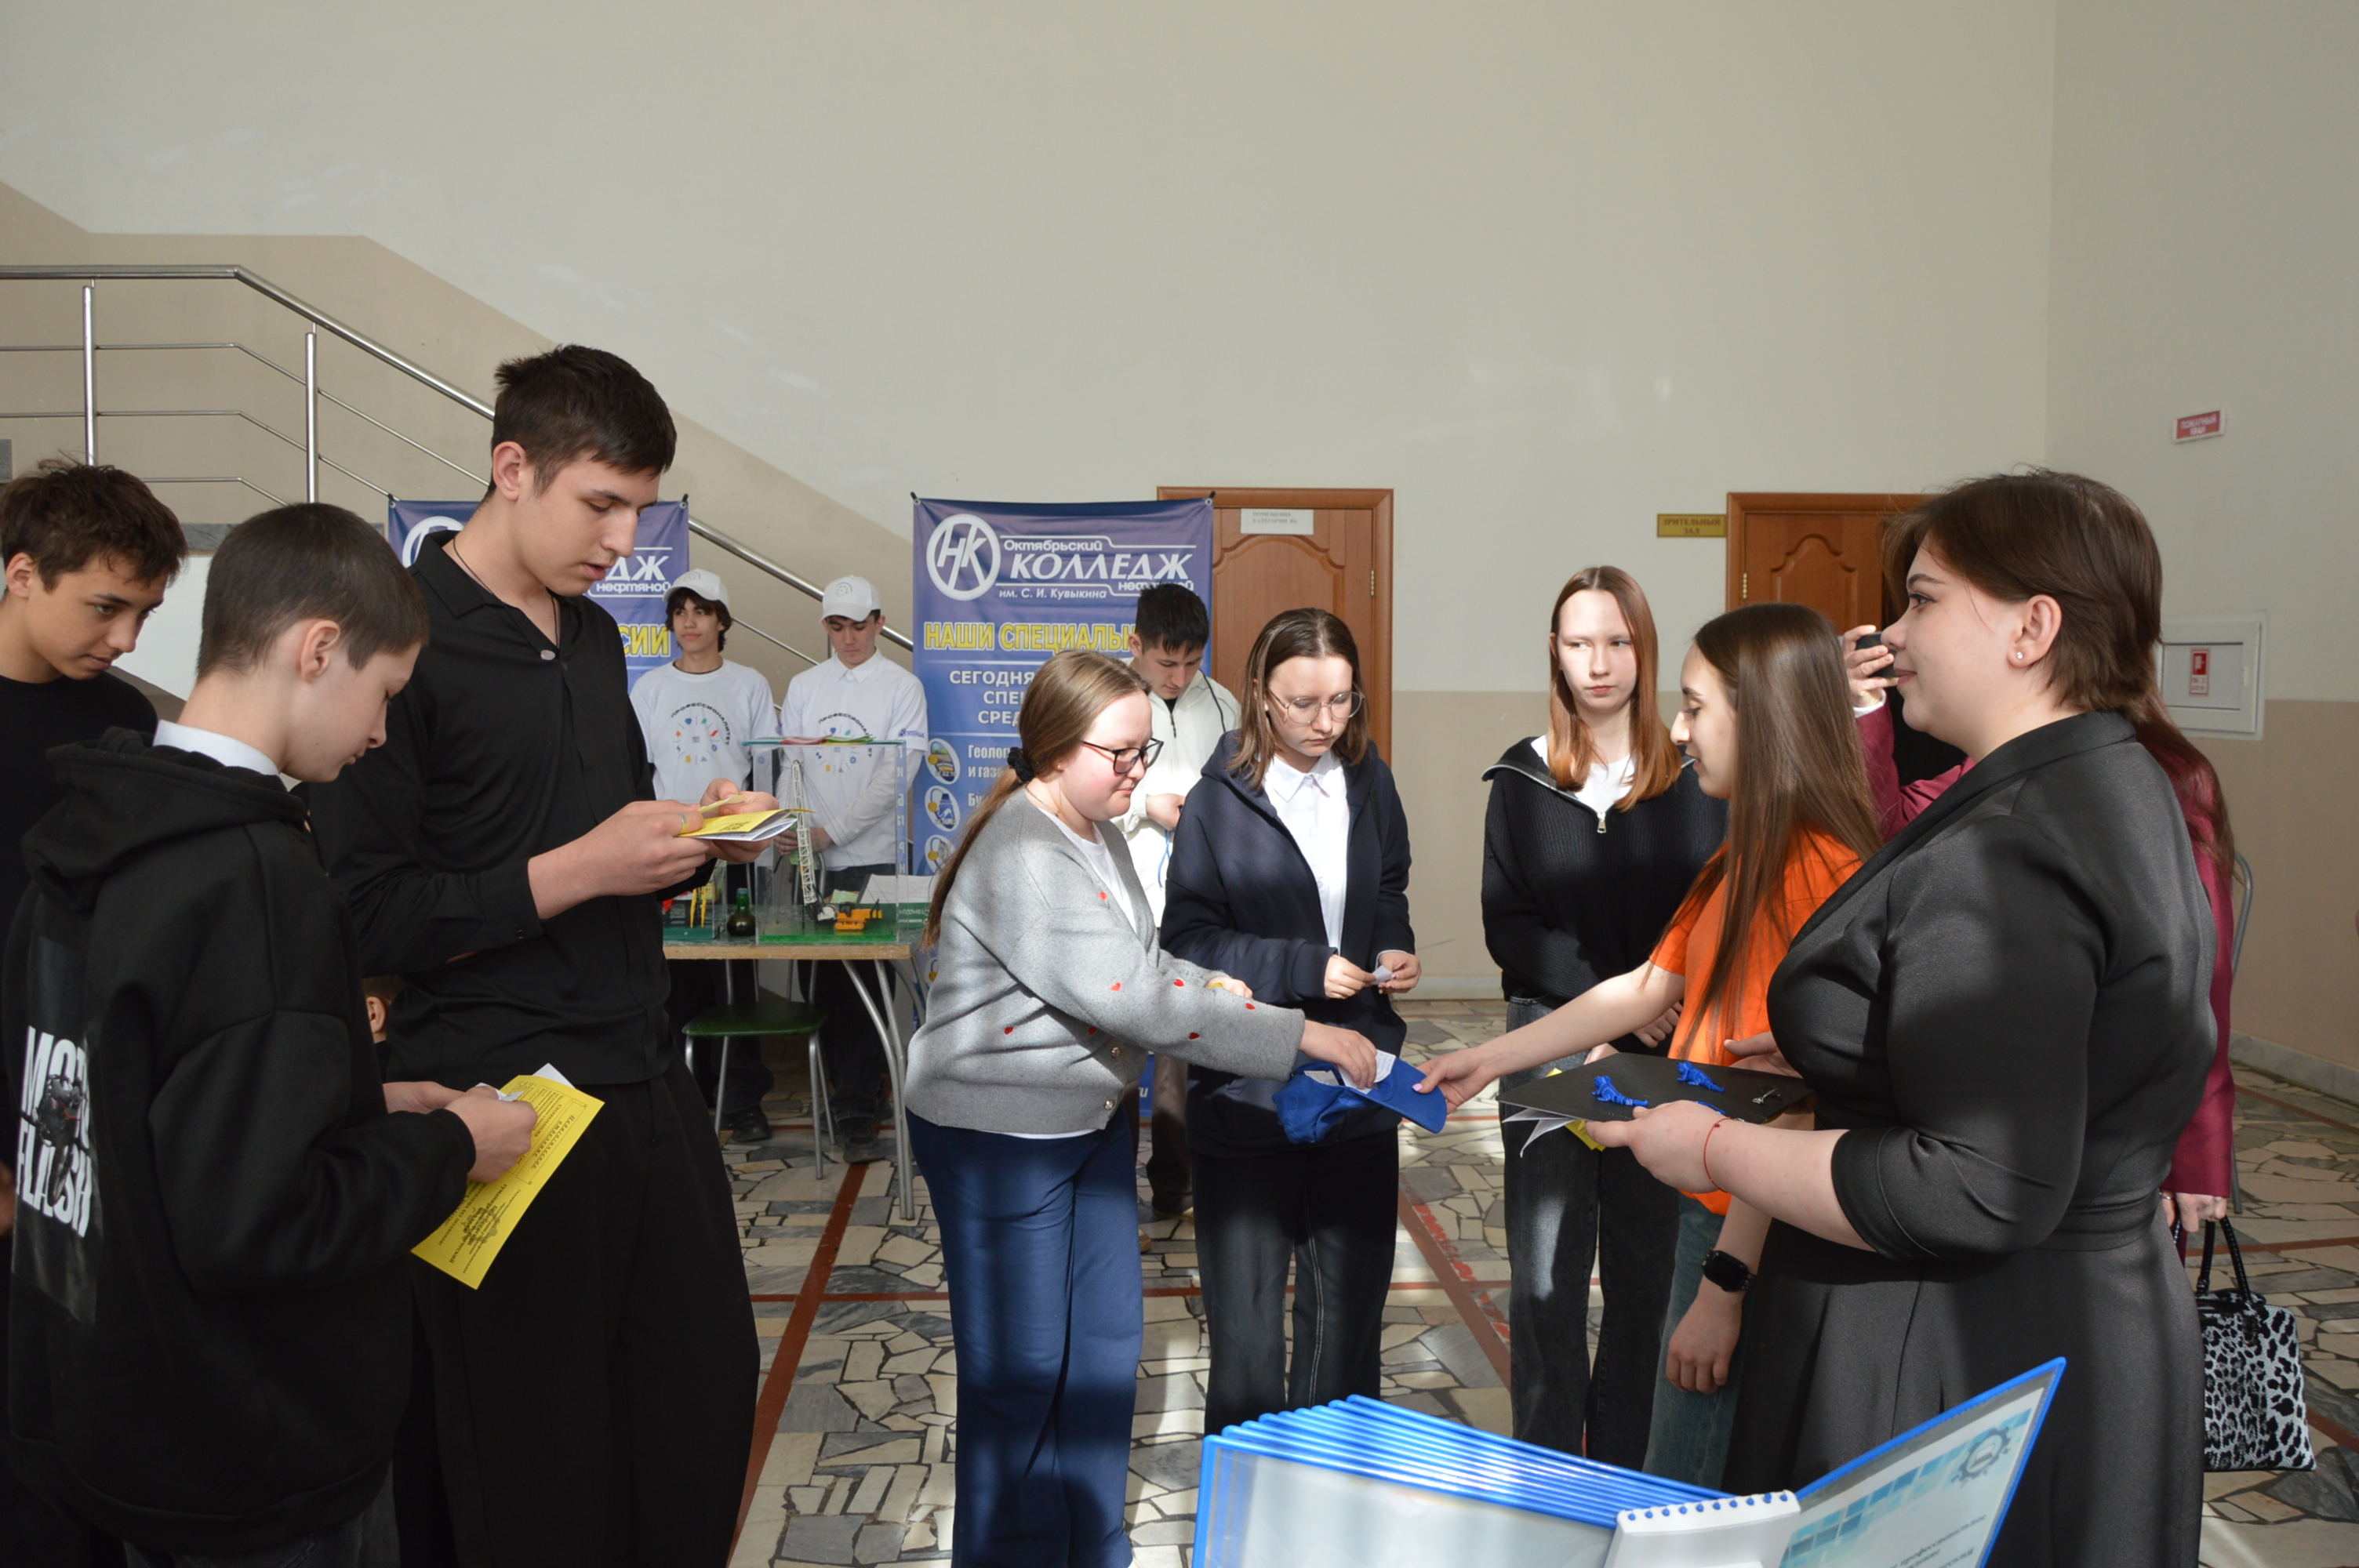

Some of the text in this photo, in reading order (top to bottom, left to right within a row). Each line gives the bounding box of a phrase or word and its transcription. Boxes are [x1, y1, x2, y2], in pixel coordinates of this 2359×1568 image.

[1003, 539, 1103, 553] Октябрьский
[1009, 553, 1193, 580] КОЛЛЕДЖ
[596, 582, 671, 594] нефтяной
[999, 588, 1107, 601] им. С. И. Кувыкина
[924, 622, 995, 651] НАШИ
[949, 670, 1034, 688] СЕГОДНЯ
[671, 702, 731, 746] ПРОФЕССИОНАЛИТЕТ
[15, 1116, 93, 1239] FLASH
